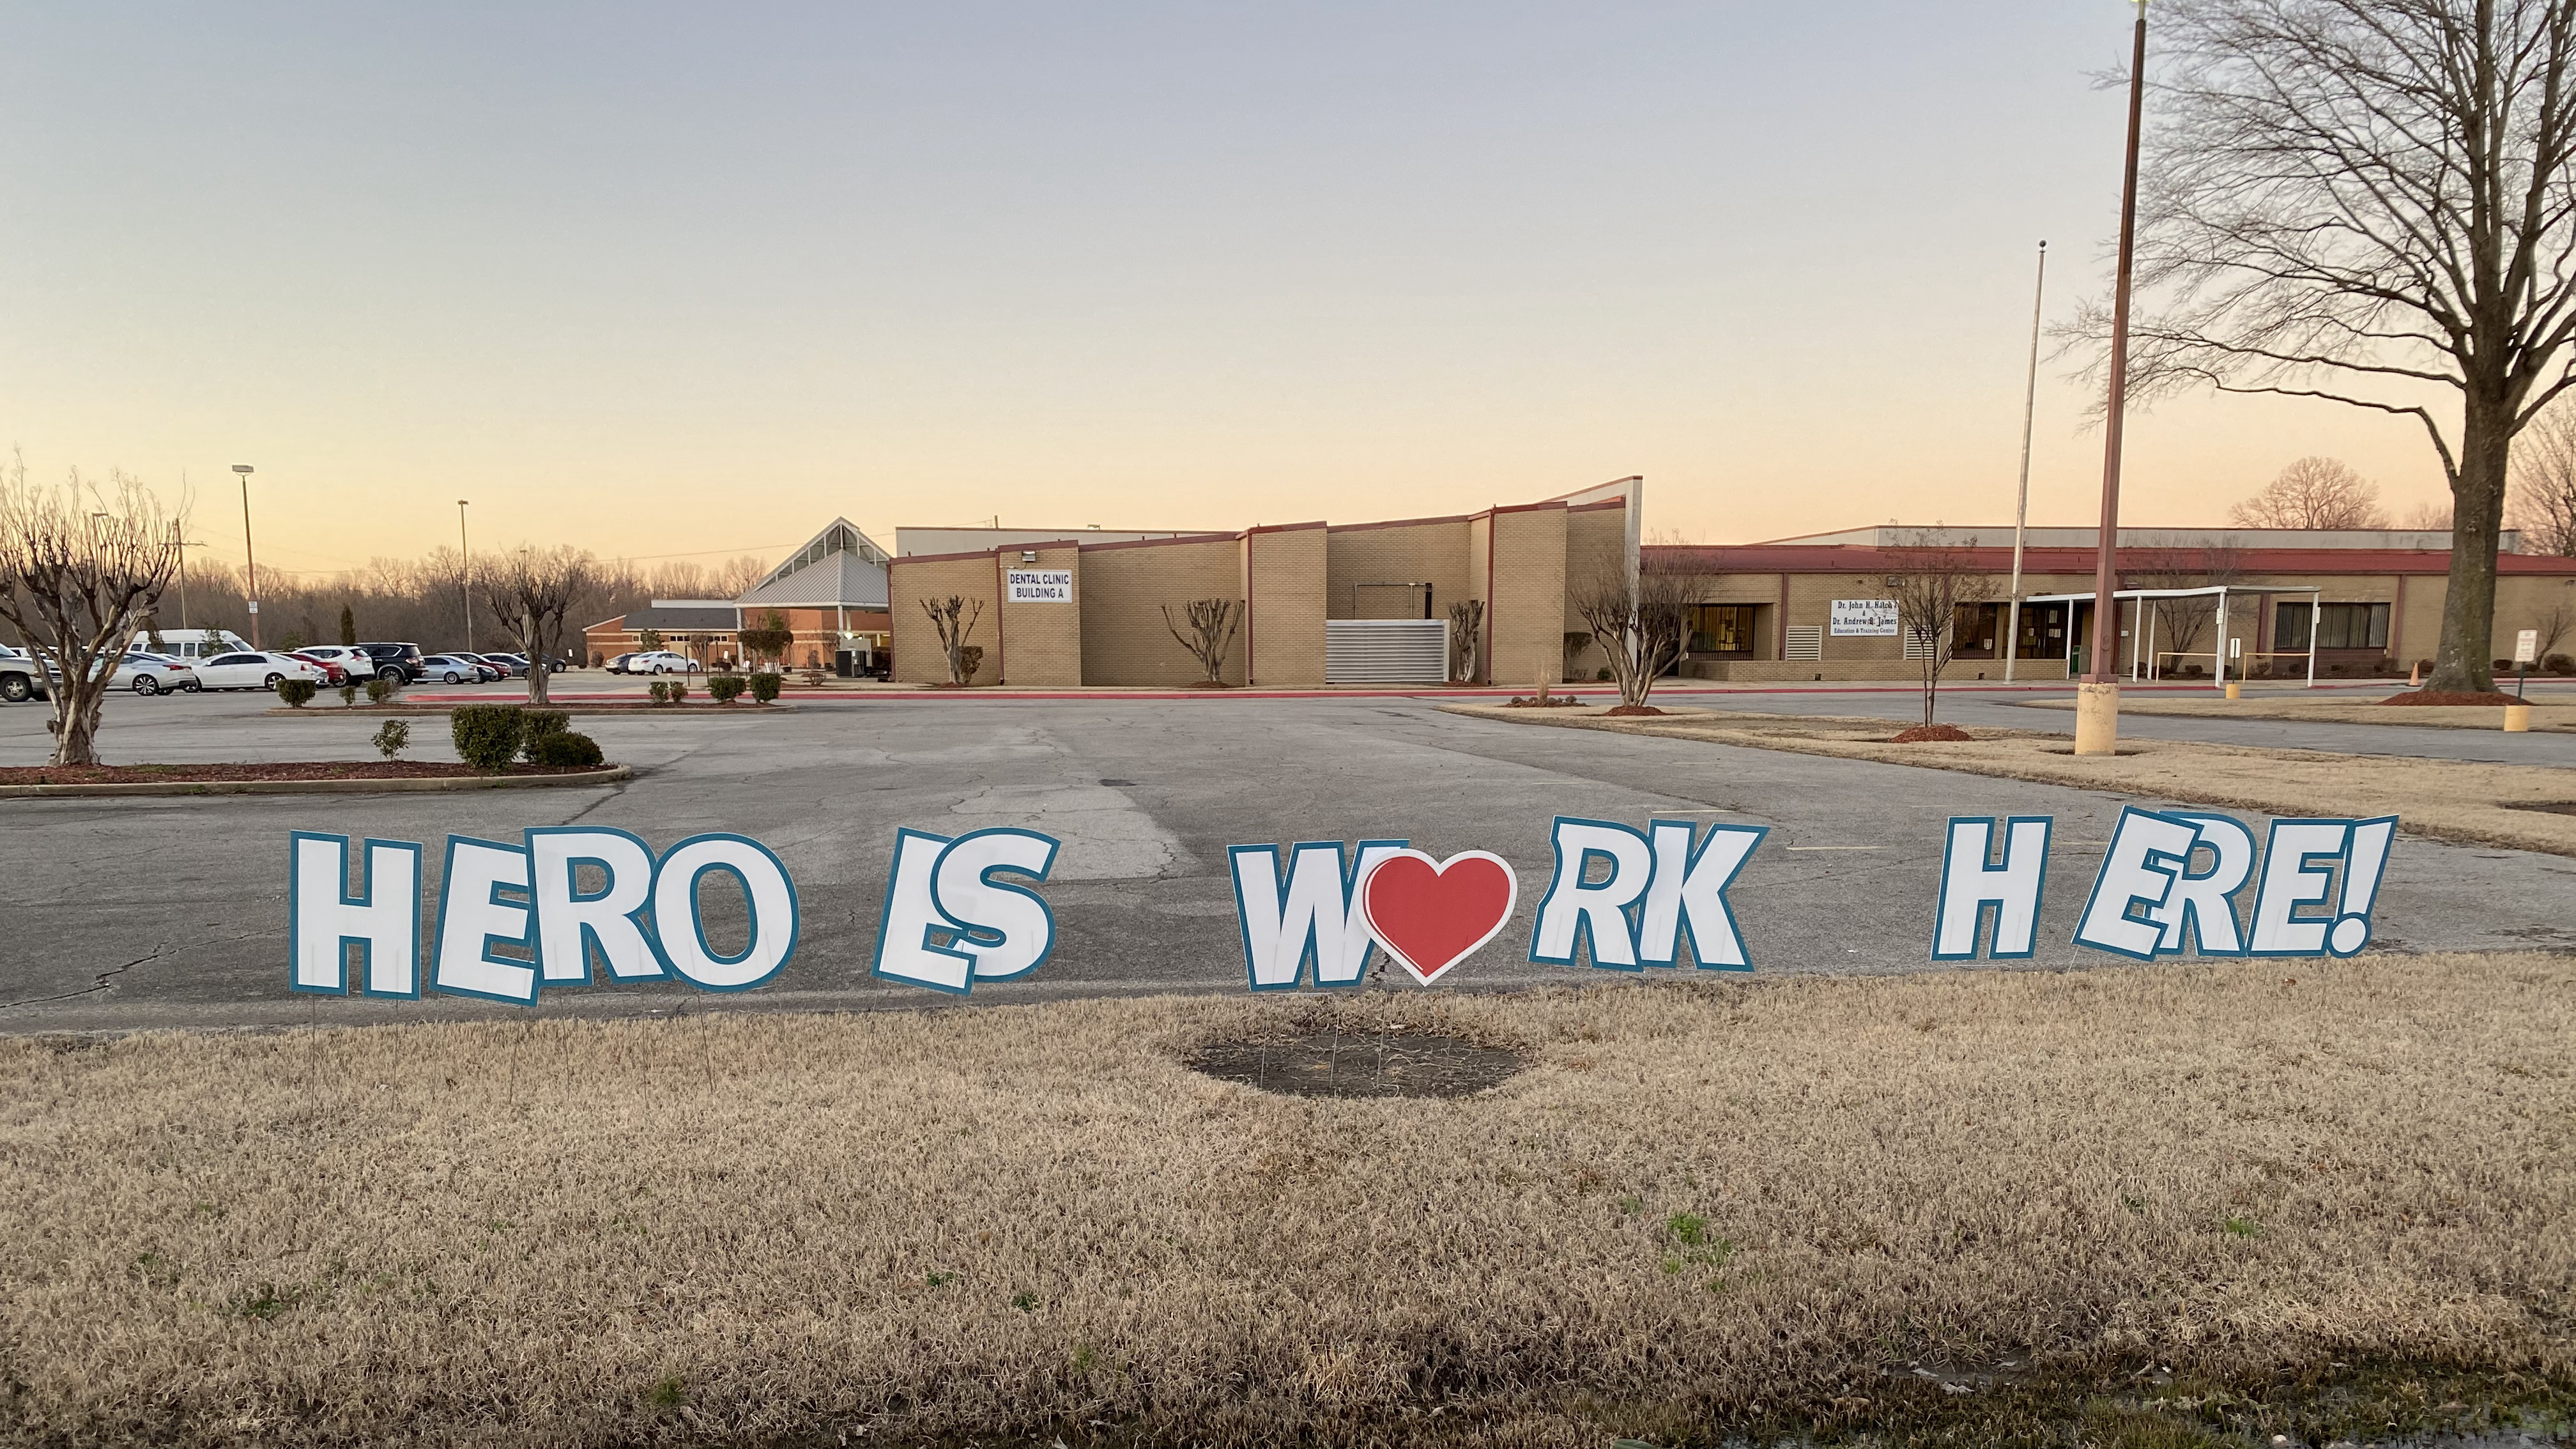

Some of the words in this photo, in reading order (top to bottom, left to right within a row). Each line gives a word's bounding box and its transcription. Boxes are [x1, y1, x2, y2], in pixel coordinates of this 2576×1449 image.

[1010, 574, 1040, 584] DENTAL
[1043, 574, 1069, 585] CLINIC
[1016, 588, 1055, 598] BUILDING
[1058, 588, 1064, 598] A
[1849, 601, 1863, 611] John
[1876, 617, 1897, 627] James
